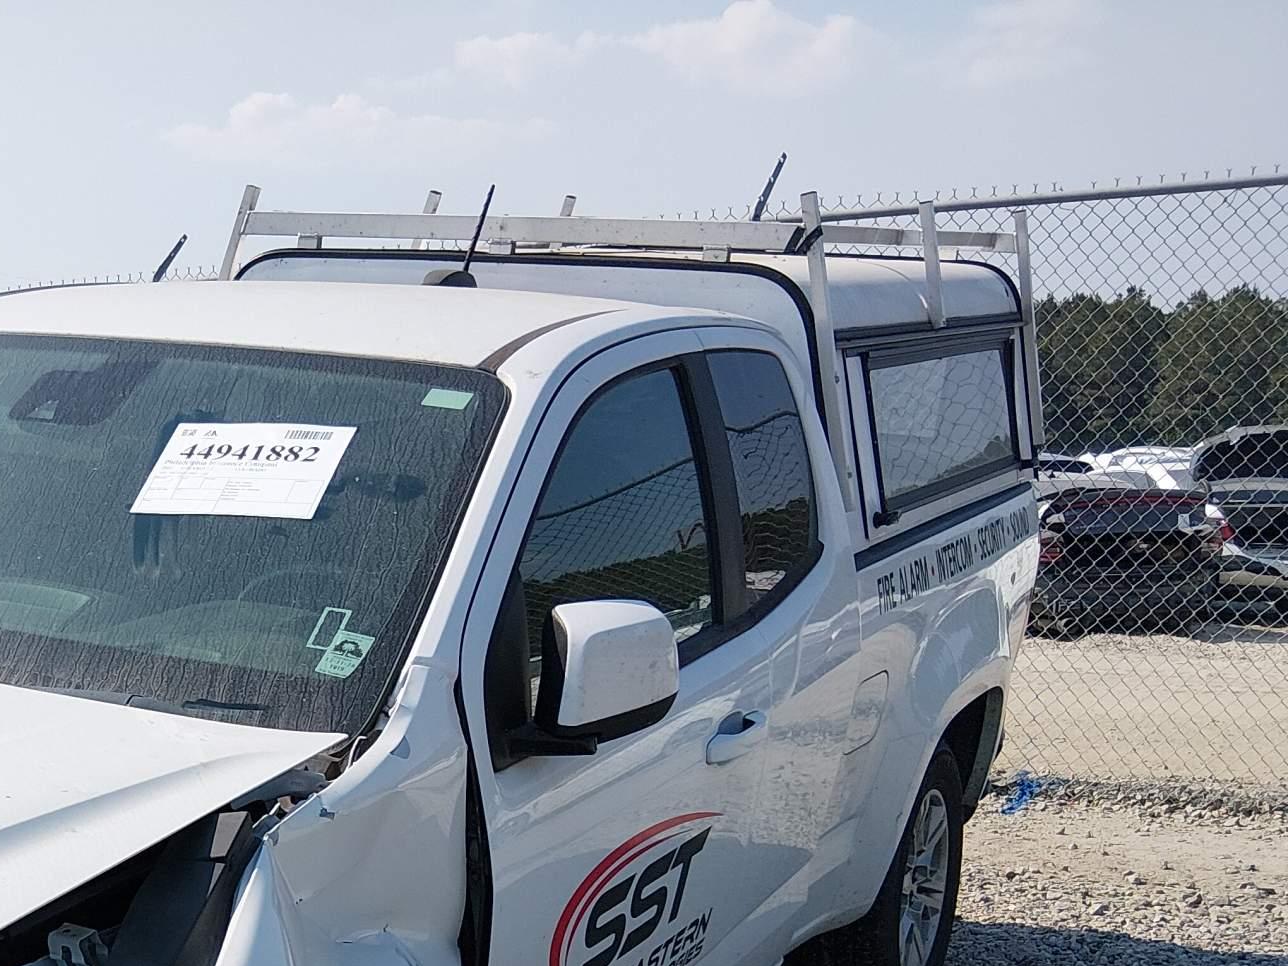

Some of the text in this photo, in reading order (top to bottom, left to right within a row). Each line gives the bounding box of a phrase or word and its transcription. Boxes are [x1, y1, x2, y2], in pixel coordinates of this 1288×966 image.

[179, 443, 321, 462] 44941882
[877, 506, 1030, 616] FIRE ALARM INTERCOM SECURITY SOUND
